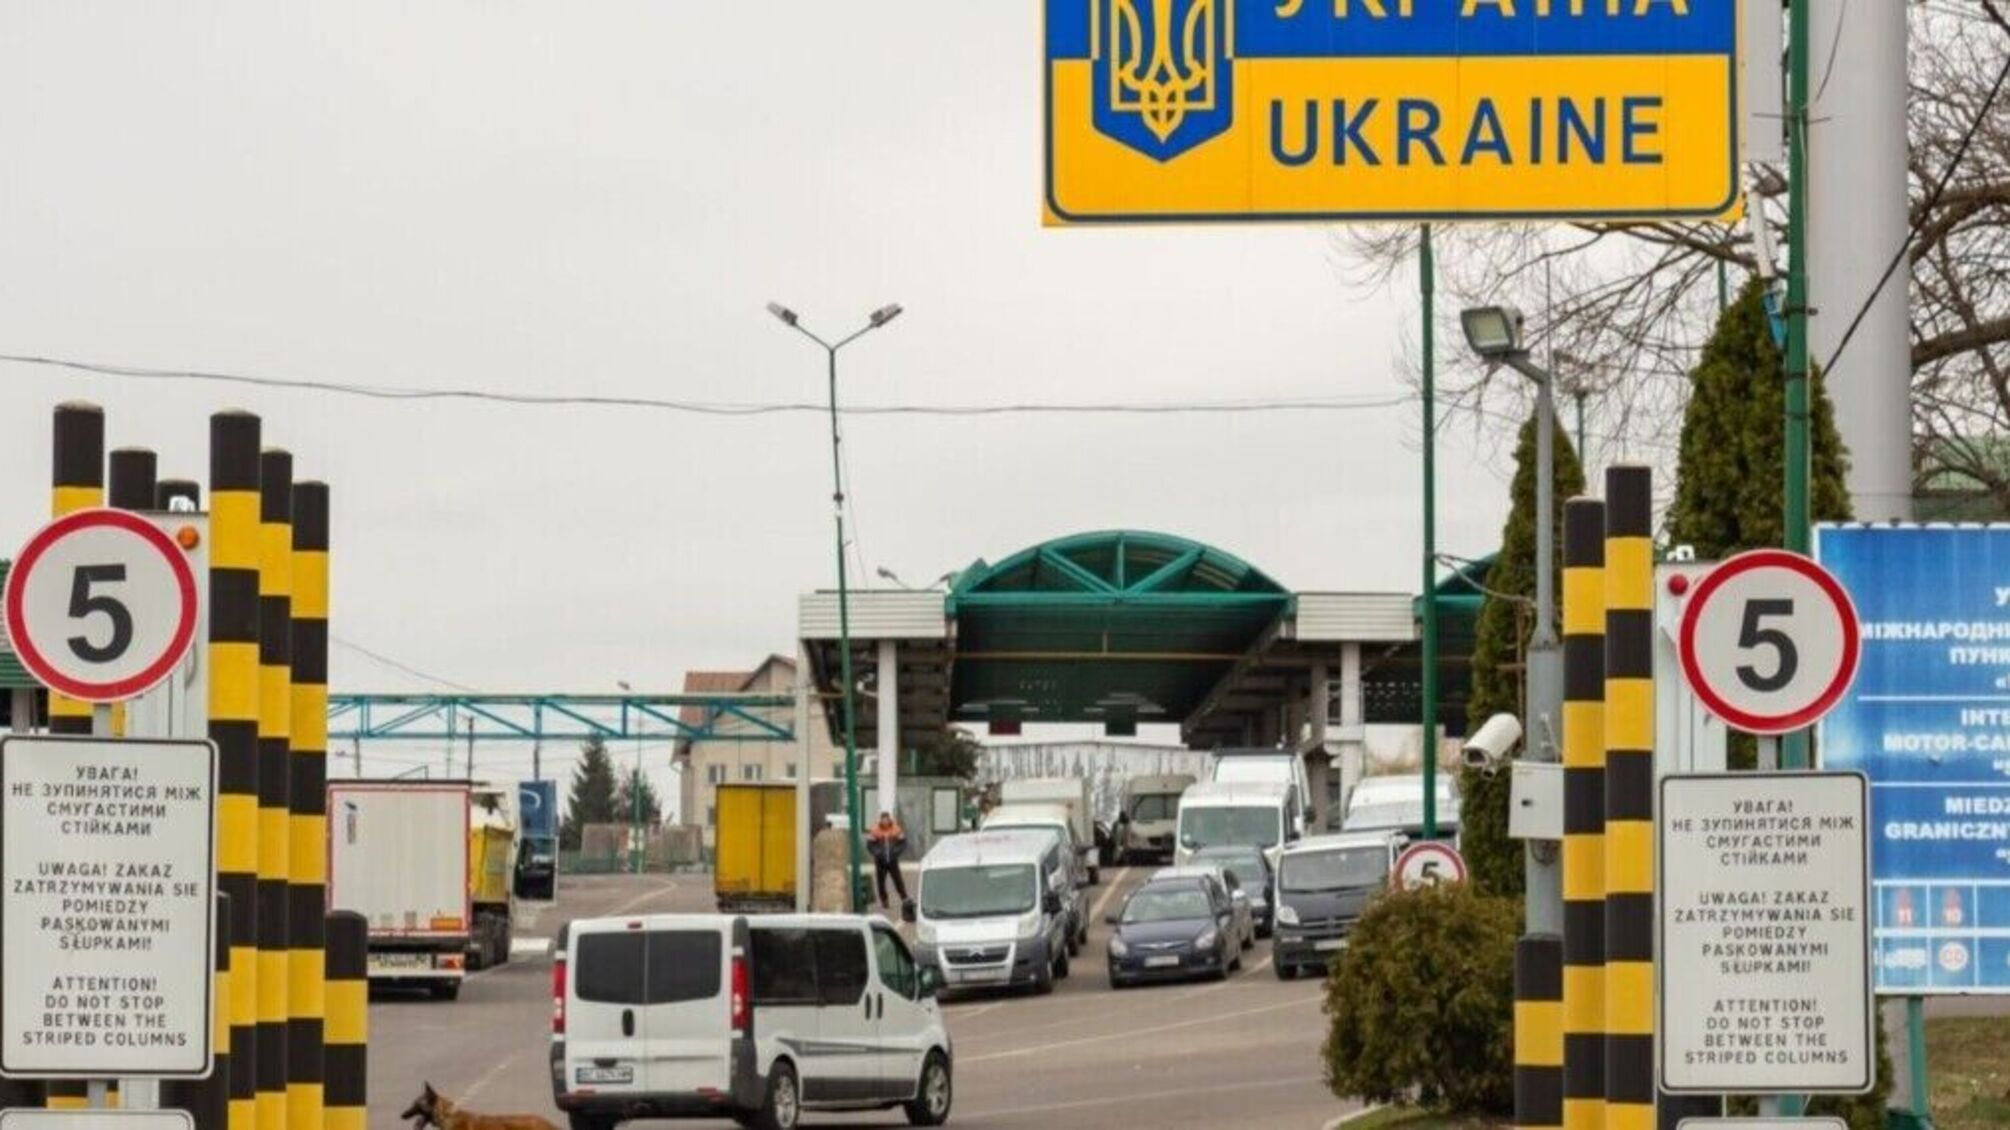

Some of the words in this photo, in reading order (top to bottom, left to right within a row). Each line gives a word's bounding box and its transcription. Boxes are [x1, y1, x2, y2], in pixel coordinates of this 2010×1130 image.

[1270, 97, 1664, 166] UKRAINE
[67, 563, 133, 663] 5
[1736, 599, 1798, 692] 5
[75, 765, 139, 782] УВАГА!
[11, 782, 33, 798] НЕ
[42, 782, 158, 801] ЗУПИНЯТИСЯ
[164, 785, 202, 801] МІЖ
[46, 801, 167, 819] СМУГАСТИМИ
[1732, 799, 1793, 815] УВАГА!
[60, 818, 152, 837] СТІЙКАМИ
[1671, 818, 1693, 833] НЕ
[1701, 816, 1812, 832] ЗУПИНЯТИСЯ
[1818, 816, 1854, 830] МІЖ
[1705, 834, 1822, 849] СМУГАСТИМИ
[1719, 849, 1808, 867] СТІЙКАМИ
[38, 861, 108, 879] UWAGA!
[114, 862, 173, 879] ZAKAZ
[1421, 861, 1440, 888] 5
[13, 878, 165, 897] ZATRZYMYWANIA
[1699, 891, 1767, 906] UWAGA!
[1773, 890, 1829, 906] ZAKAZ
[40, 915, 170, 933] PASKOWANYMI
[1674, 907, 1822, 924] ZATRZYMYWANIA
[1701, 942, 1829, 958] PASKOWANYMI
[52, 975, 158, 992] ATTENTION!
[44, 994, 69, 1009] DO
[76, 994, 111, 1010] NOT
[119, 994, 164, 1011] STOP
[1713, 998, 1817, 1013] ATTENTION!
[42, 1012, 127, 1029] BETWEEN
[134, 1012, 166, 1029] THE
[1706, 1016, 1730, 1031] DO
[1737, 1015, 1772, 1030] NOT
[1780, 1015, 1825, 1030] STOP
[22, 1030, 97, 1046] STRIPED
[103, 1031, 187, 1047] COLUMNS
[1703, 1032, 1788, 1048] BETWEEN
[1794, 1032, 1827, 1047] THE
[1684, 1050, 1757, 1065] STRIPED
[1764, 1049, 1849, 1065] COLUMNS
